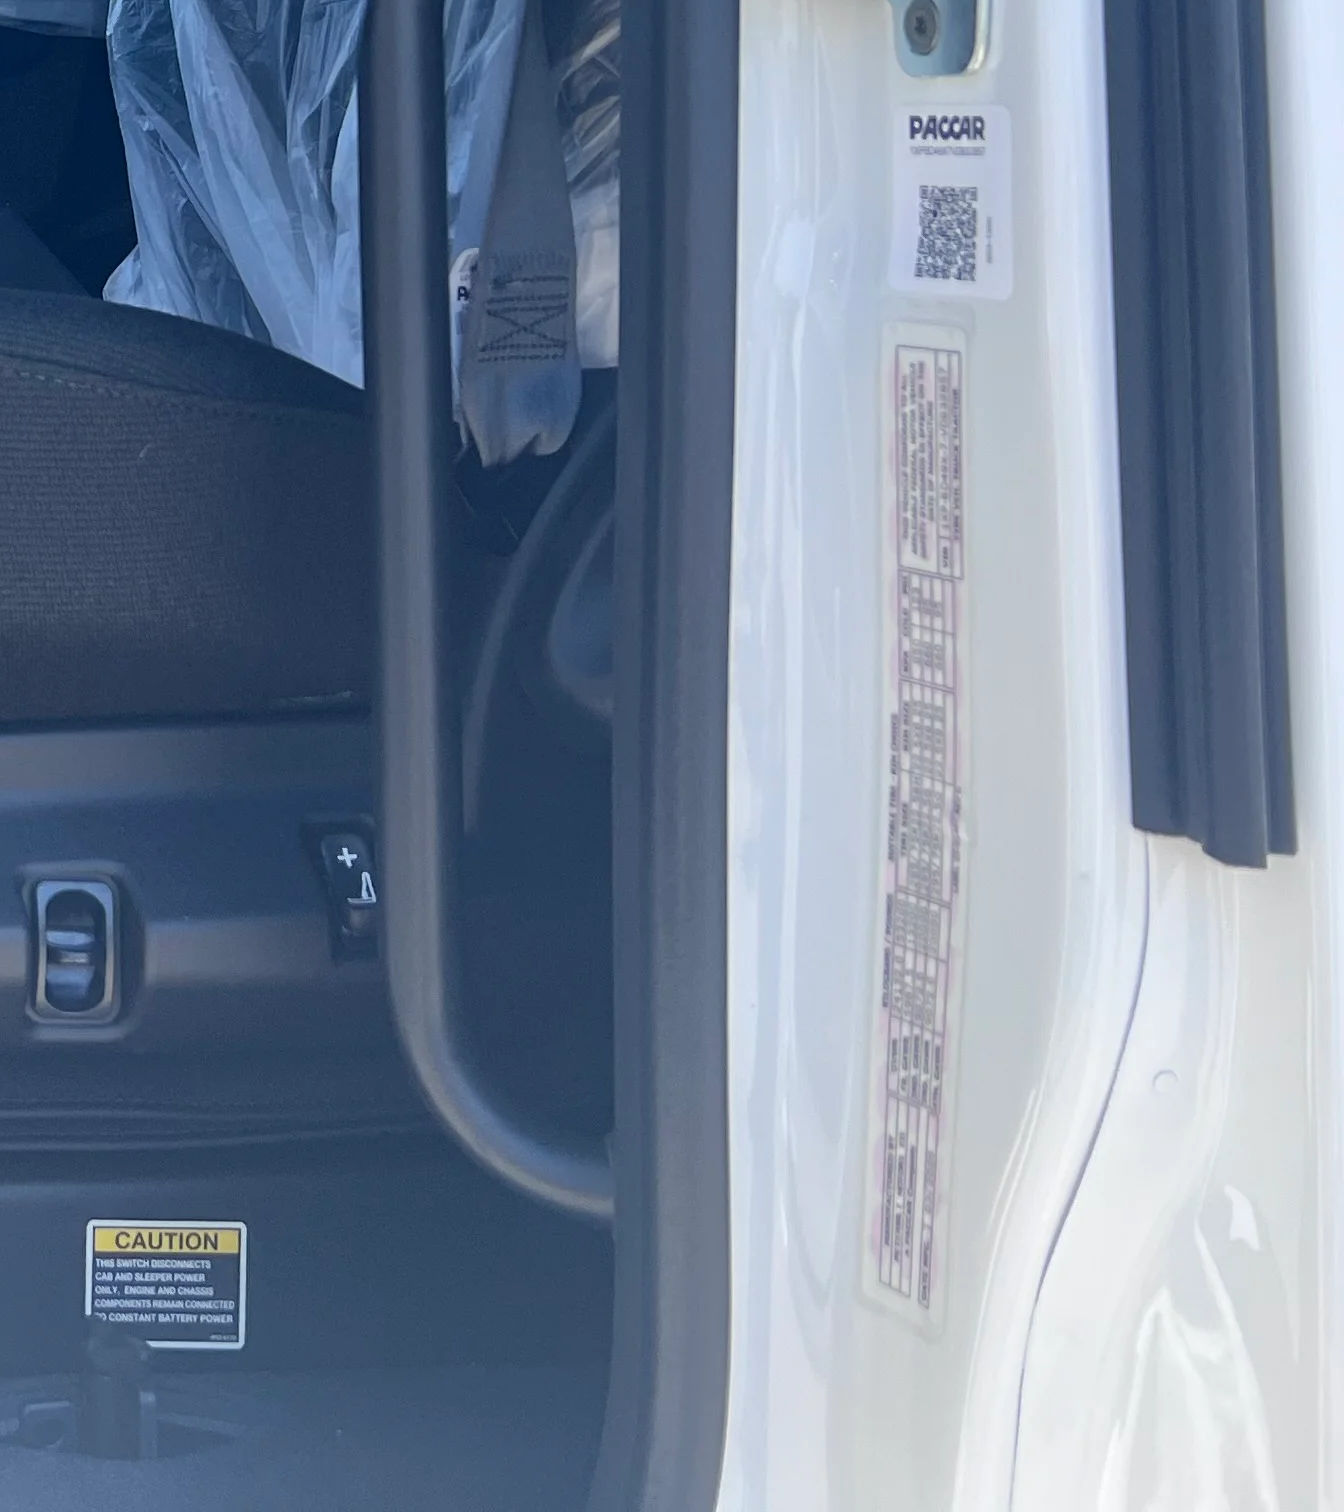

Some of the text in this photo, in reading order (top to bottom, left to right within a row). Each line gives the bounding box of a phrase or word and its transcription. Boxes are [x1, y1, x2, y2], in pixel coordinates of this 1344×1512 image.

[909, 115, 985, 140] PACCAR
[115, 1231, 219, 1251] CAUTION
[95, 1258, 212, 1269] THIS SWITCH DISCONNECTS
[95, 1272, 206, 1282] CAB AND SLEEPER POWER
[124, 1285, 157, 1295] ENGINE
[157, 1285, 177, 1295] AND
[177, 1286, 214, 1296] CHASSIS
[94, 1298, 235, 1310] COMPONENTS REMAIN CONNECTED
[108, 1312, 157, 1322] CONSTANT
[158, 1312, 199, 1323] BATTERY
[199, 1313, 234, 1323] POWER
